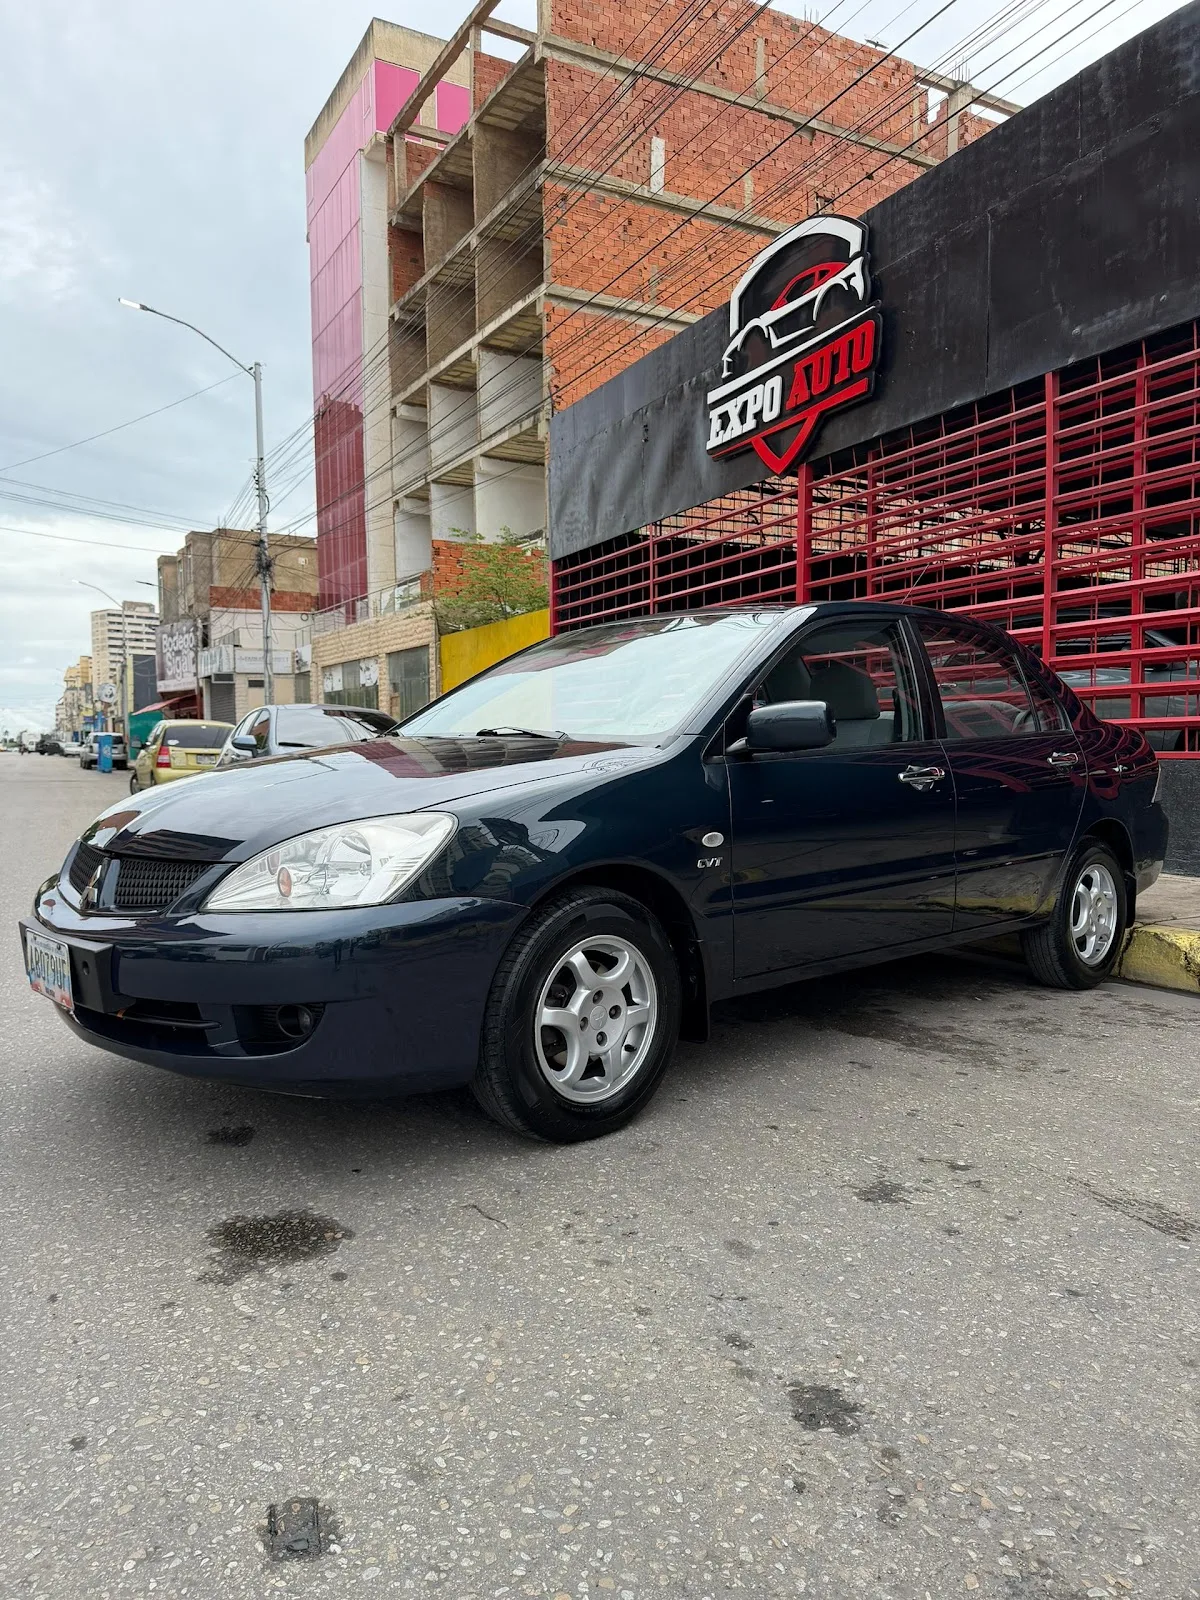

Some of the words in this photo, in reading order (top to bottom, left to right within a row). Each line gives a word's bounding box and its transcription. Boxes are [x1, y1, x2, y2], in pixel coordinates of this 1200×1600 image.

[706, 375, 782, 450] EXPO
[786, 320, 875, 411] AUTO
[697, 856, 723, 869] CVT
